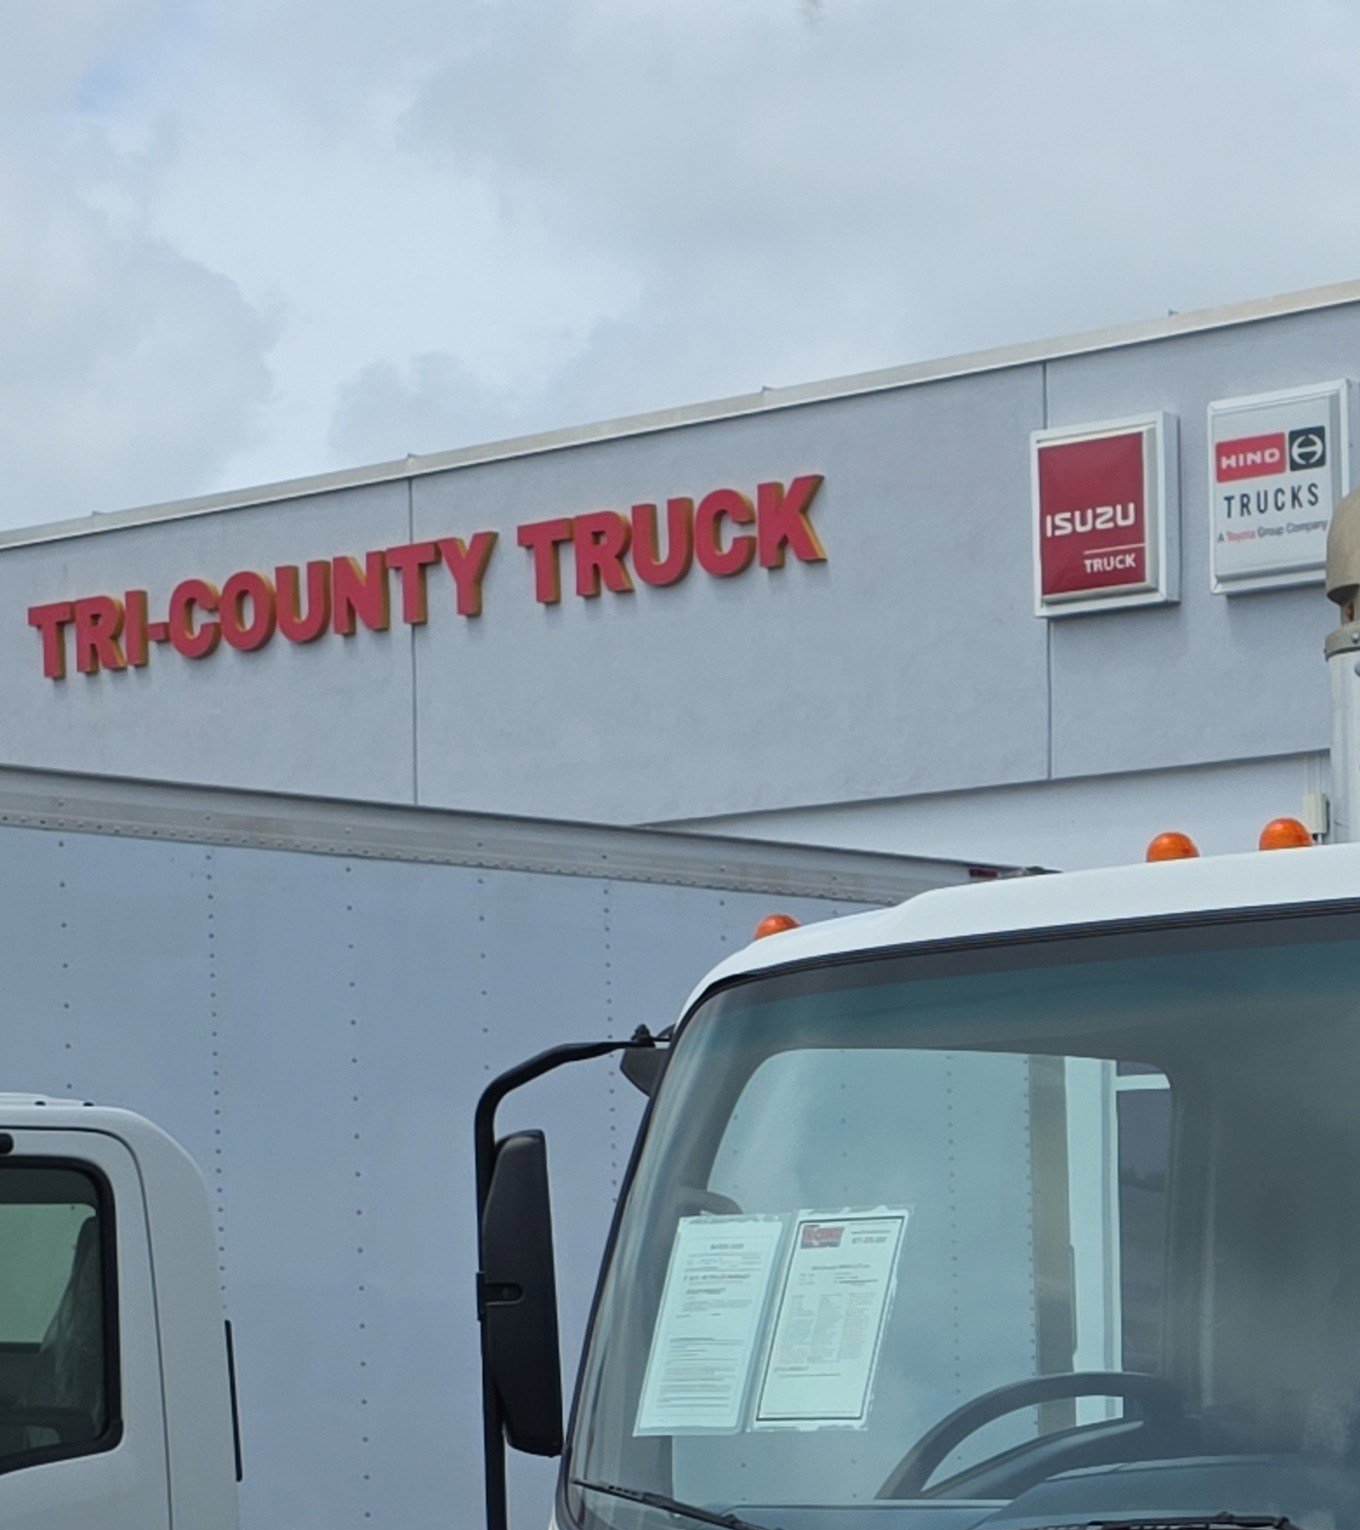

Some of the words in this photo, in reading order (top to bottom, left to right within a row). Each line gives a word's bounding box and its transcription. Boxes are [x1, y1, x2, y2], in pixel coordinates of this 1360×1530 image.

[1221, 448, 1281, 470] HINO
[1223, 482, 1320, 519] TRUCKS
[1045, 502, 1136, 538] ISUZU
[28, 531, 498, 679] TRI-COUNTY
[518, 475, 826, 603] TRUCK
[1083, 552, 1137, 574] TRUCK
